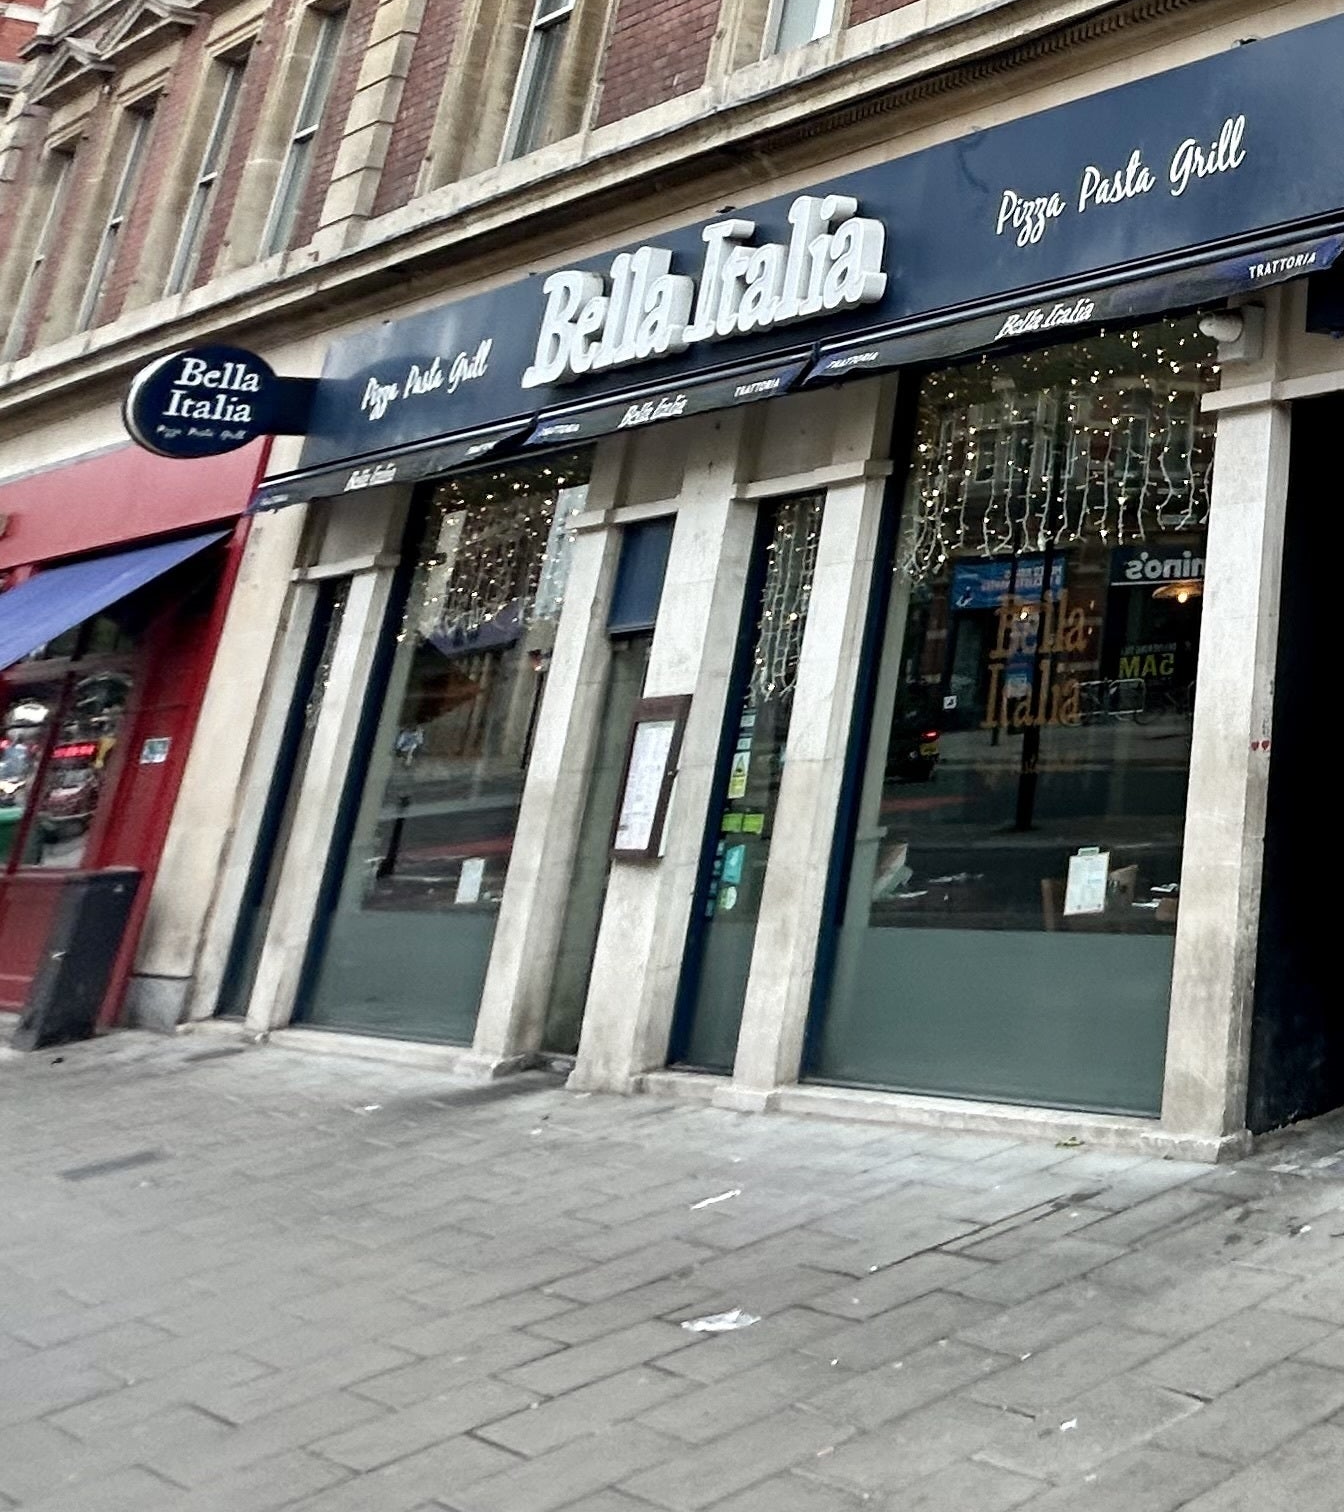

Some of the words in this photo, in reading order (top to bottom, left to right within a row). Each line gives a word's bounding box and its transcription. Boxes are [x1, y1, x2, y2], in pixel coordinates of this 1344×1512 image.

[996, 190, 1066, 247] Pizza
[1078, 150, 1155, 212] Pasta
[1169, 115, 1246, 196] Grill
[1249, 252, 1317, 279] TRATTORIA
[521, 246, 695, 388] Bella
[683, 194, 888, 342] Italia
[994, 309, 1044, 340] Bella
[1041, 298, 1095, 328] Italia
[173, 357, 260, 393] Bella
[360, 377, 399, 421] Pizza
[402, 357, 445, 399] Pasta
[447, 338, 493, 394] Grill
[162, 389, 252, 423] Italia
